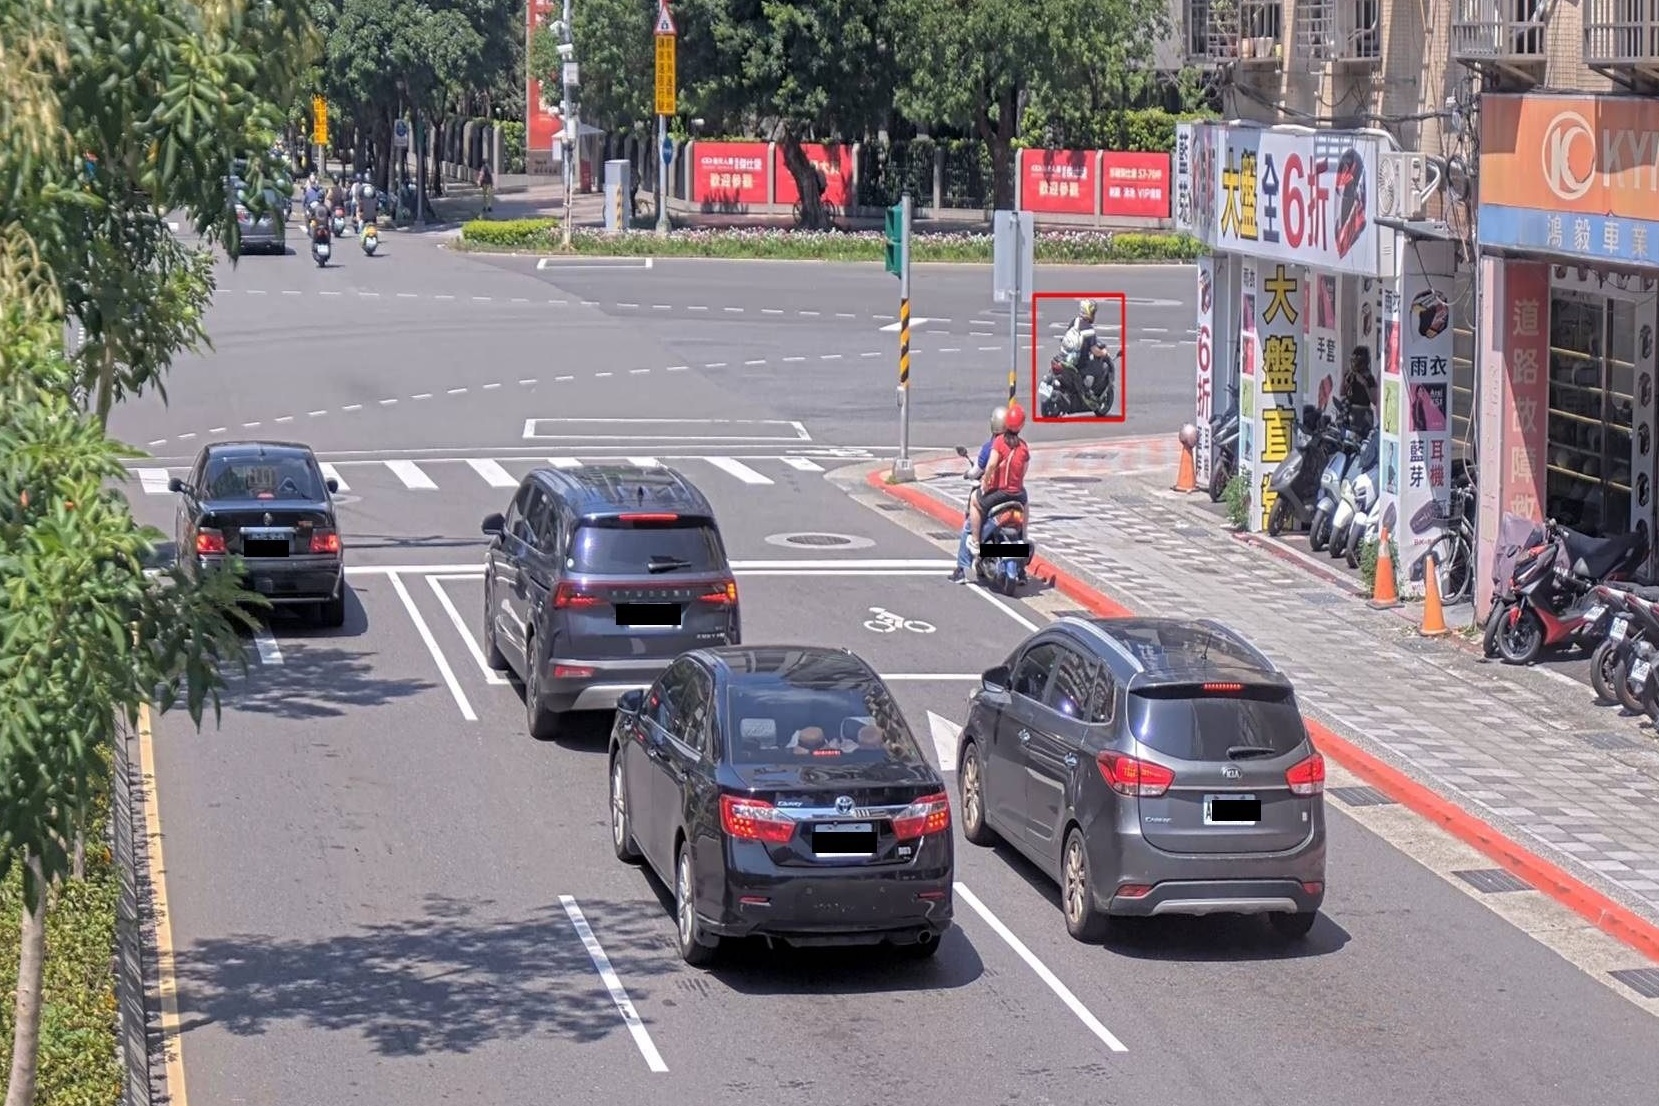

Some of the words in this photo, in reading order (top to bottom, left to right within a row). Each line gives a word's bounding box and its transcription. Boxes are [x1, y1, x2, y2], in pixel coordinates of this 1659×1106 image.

[1546, 213, 1650, 257] 鴻毅車業
[1316, 336, 1336, 363] 手套
[1409, 355, 1448, 377] 雨衣
[1409, 439, 1424, 488] 藍芽
[1430, 439, 1445, 487] 耳機
